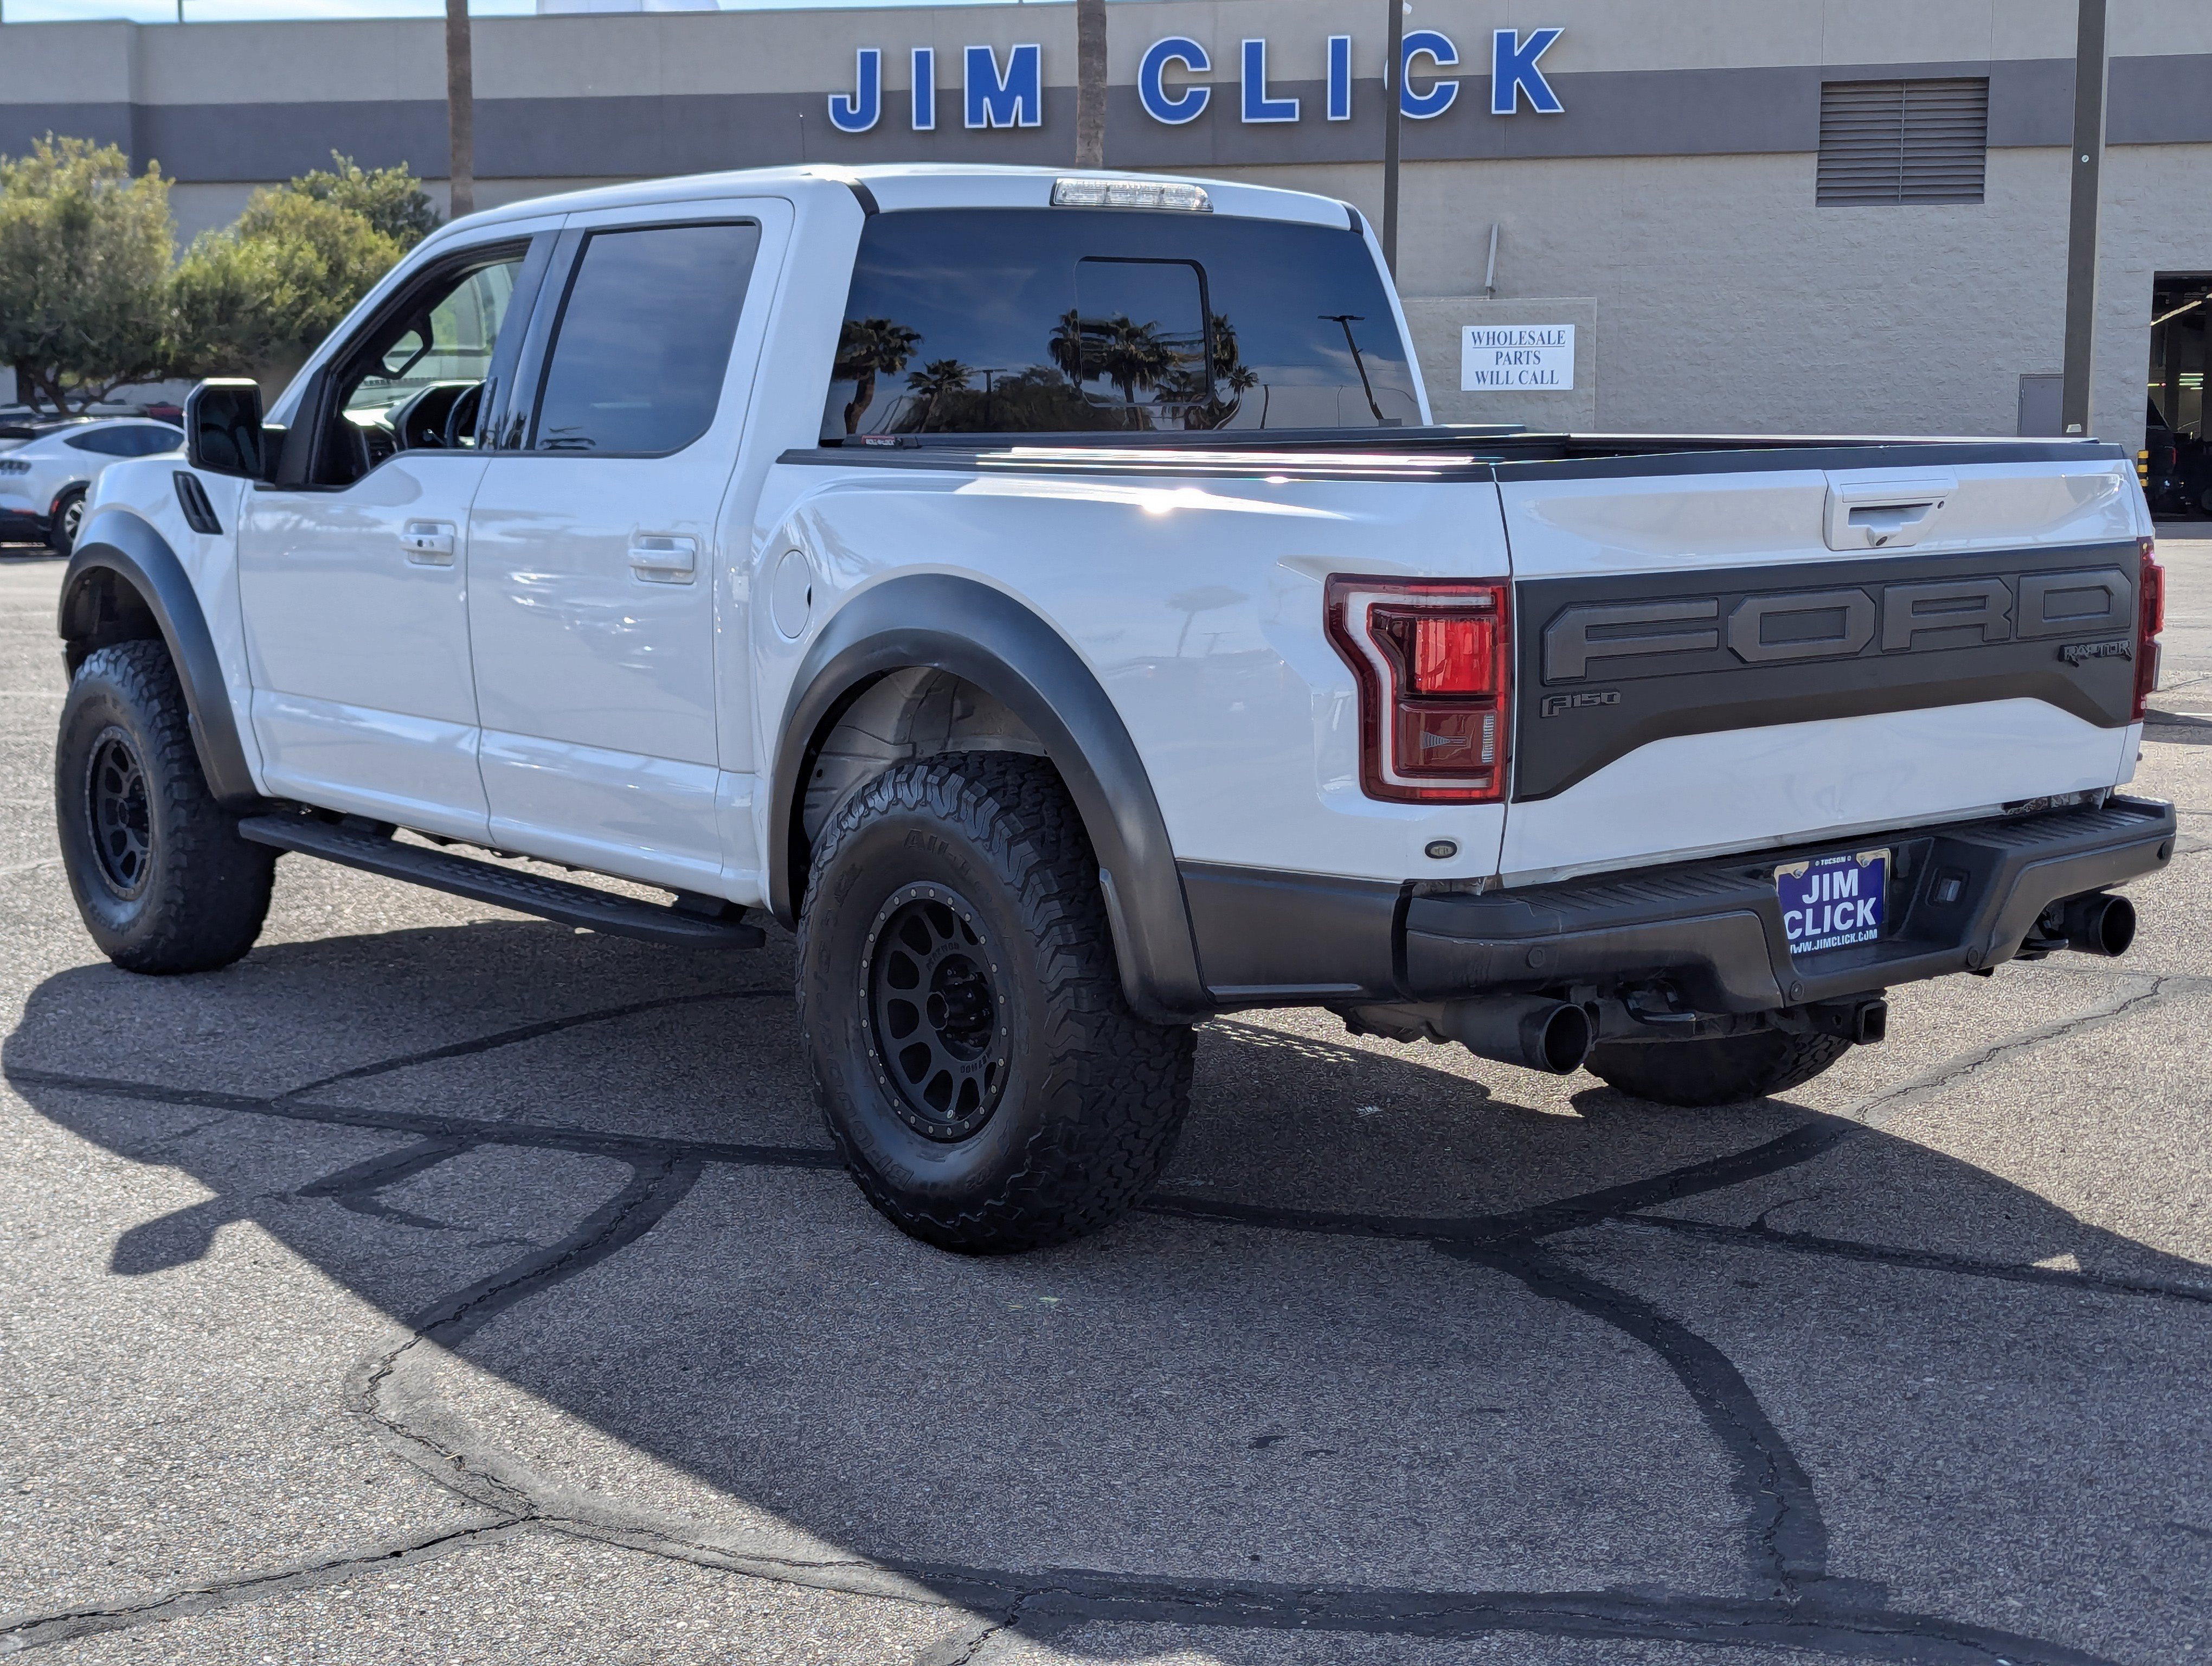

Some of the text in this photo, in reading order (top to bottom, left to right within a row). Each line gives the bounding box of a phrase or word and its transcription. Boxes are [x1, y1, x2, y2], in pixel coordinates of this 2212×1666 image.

[828, 27, 1565, 132] JIM CLICK
[1471, 330, 1566, 346] WHOLESALE
[1495, 350, 1541, 366] PARTS
[1475, 370, 1559, 385] WILL CALL
[1542, 566, 2132, 685] FORD
[1802, 869, 1859, 904] JIM
[1784, 897, 1876, 940] CLICK
